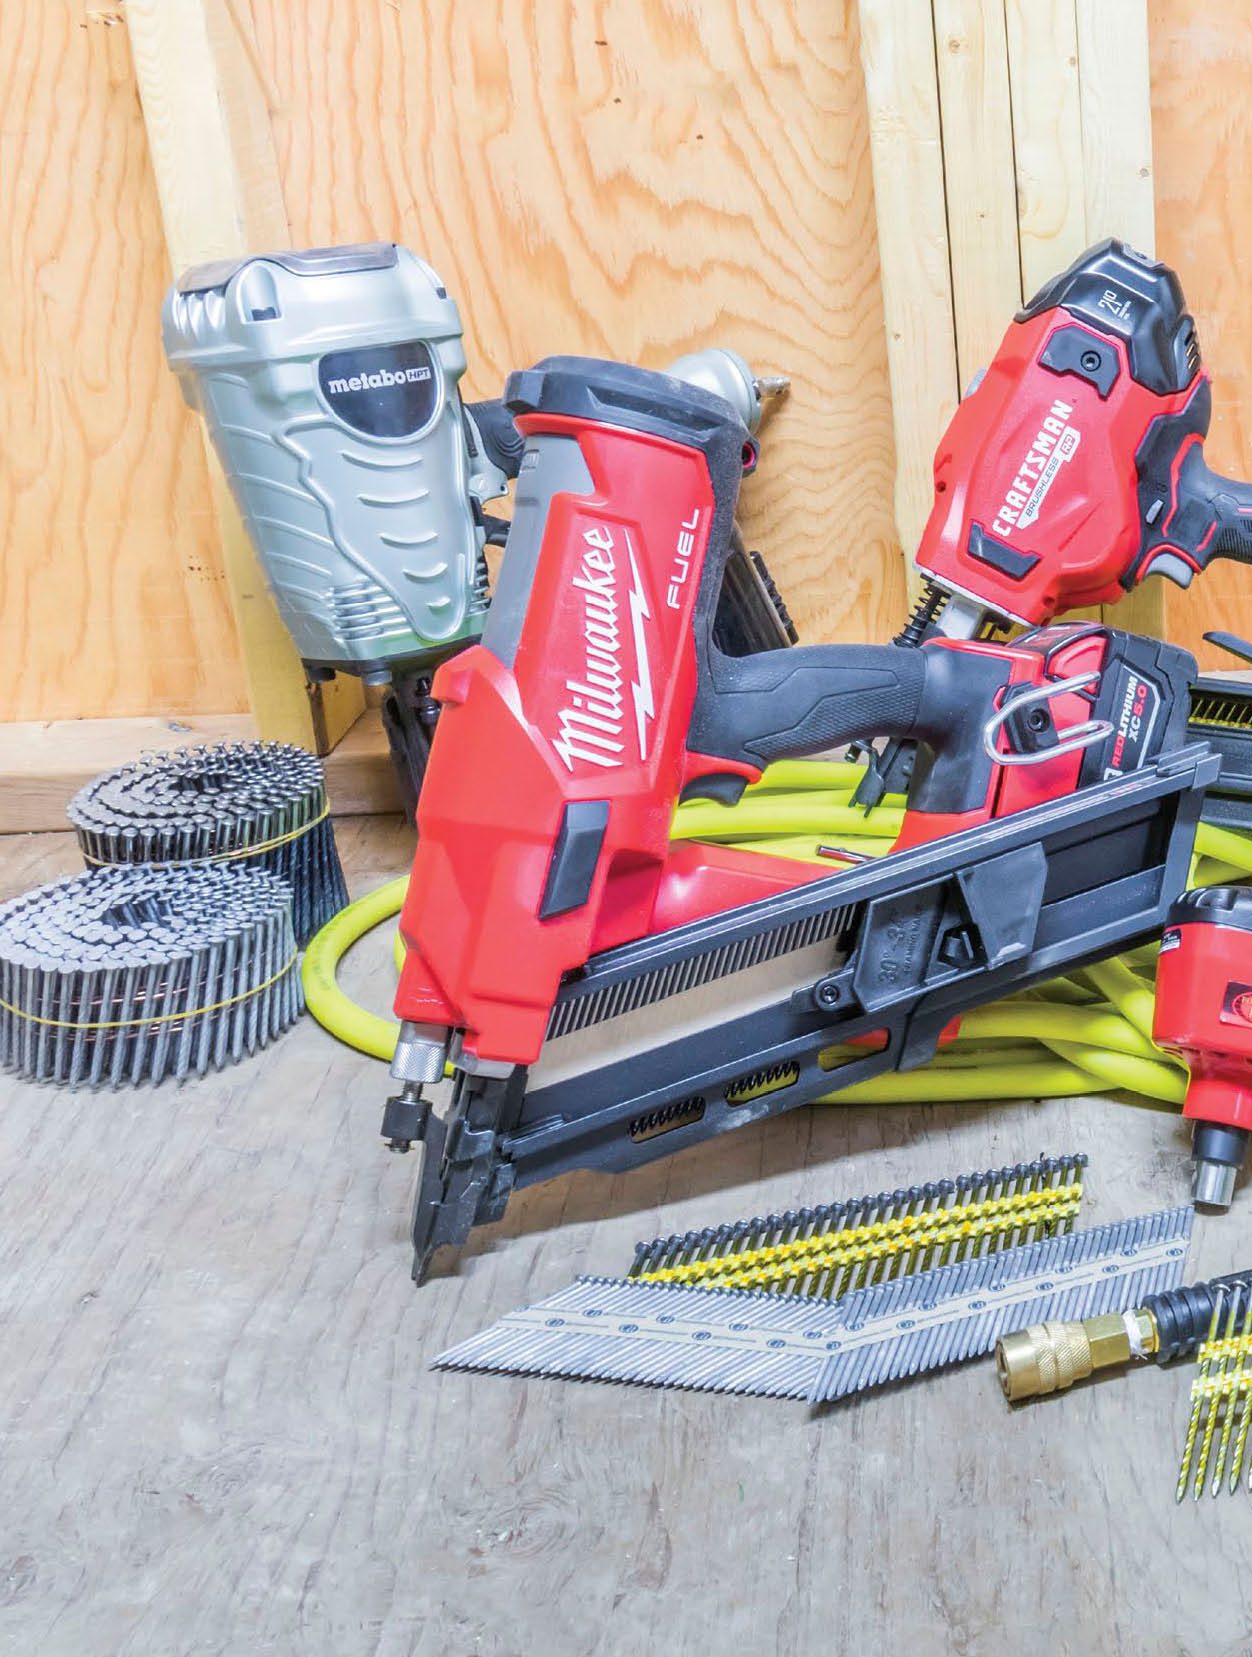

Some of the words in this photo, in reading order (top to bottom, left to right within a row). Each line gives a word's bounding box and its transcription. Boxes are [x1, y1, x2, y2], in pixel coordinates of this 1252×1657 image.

[328, 370, 406, 394] metabo
[406, 367, 431, 382] HPT
[992, 400, 1074, 537] CRAFTSMAN
[1025, 456, 1060, 517] BRUSHLESS
[667, 508, 700, 610] FUEL
[551, 525, 625, 773] Milwaukee
[1111, 675, 1139, 768] REDLITHIUM
[1127, 684, 1148, 743] XC5.0
